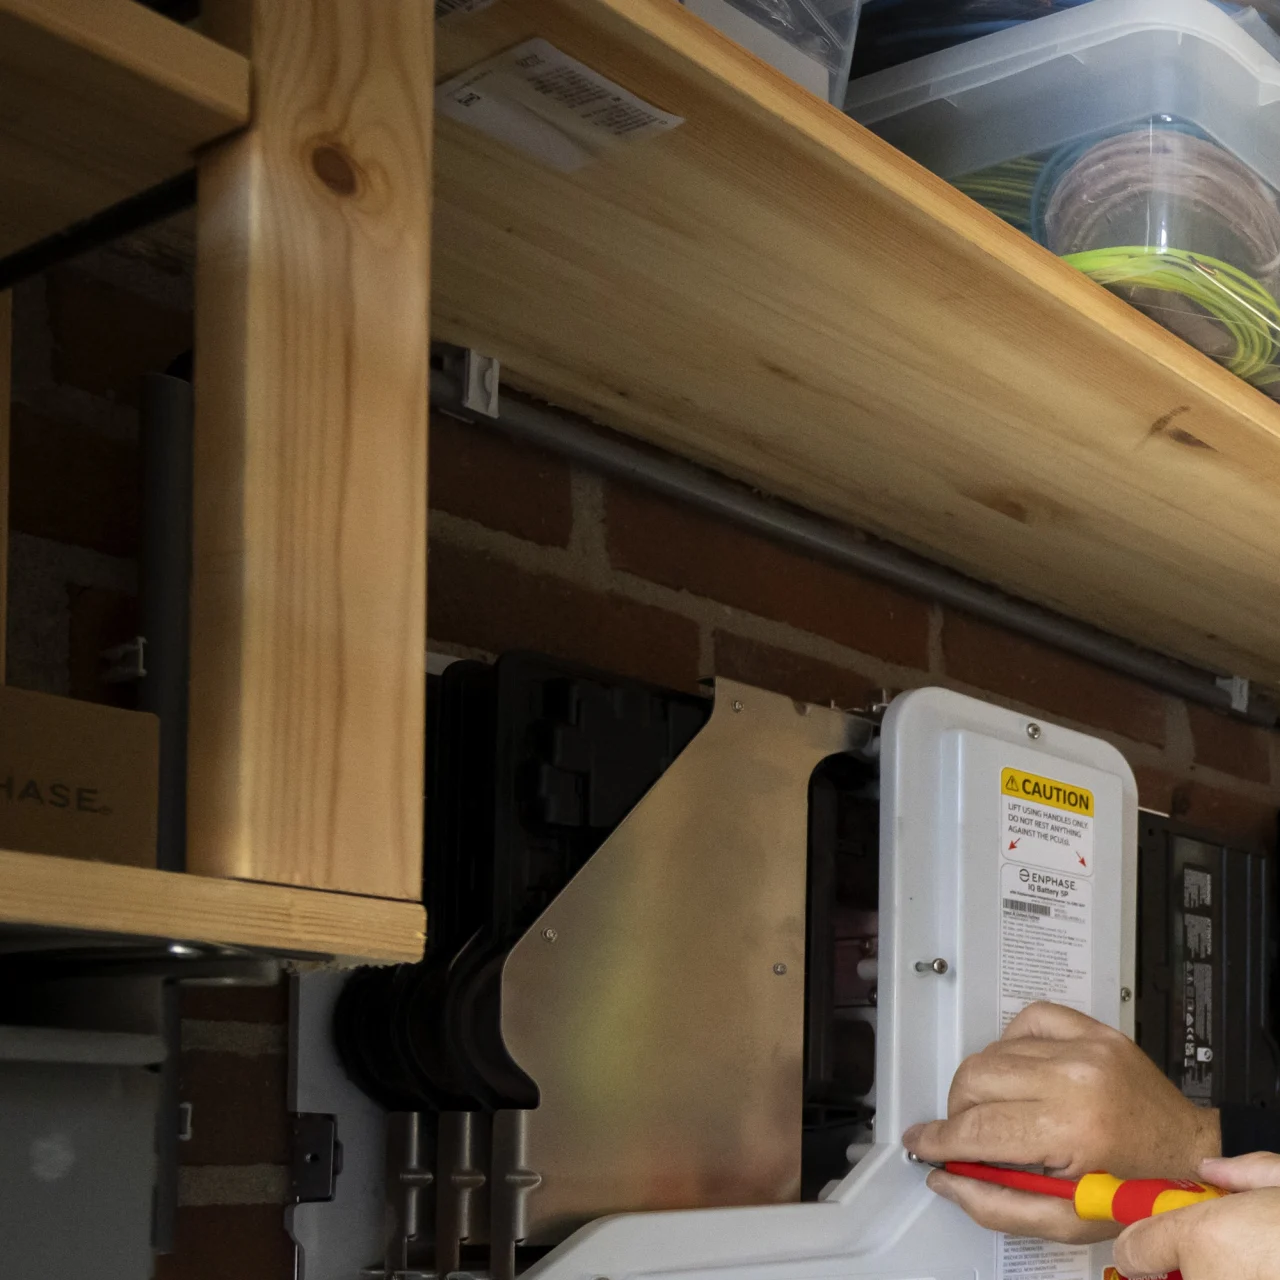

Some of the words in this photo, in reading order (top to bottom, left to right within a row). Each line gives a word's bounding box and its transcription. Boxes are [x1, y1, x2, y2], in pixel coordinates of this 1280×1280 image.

[1022, 779, 1089, 811] CAUTION
[1008, 802, 1021, 811] LIFT
[1022, 806, 1042, 817] USING
[1043, 811, 1072, 825] HANDLES
[1008, 814, 1018, 822] DO
[1020, 817, 1033, 826] NOT
[1035, 820, 1049, 830] REST
[1050, 825, 1082, 838] ANYTHING
[1008, 825, 1036, 837] AGAINST
[1037, 831, 1049, 841] THE
[1028, 884, 1035, 892] IQ
[1037, 885, 1059, 898] Battery
[1032, 873, 1076, 890] ENPHASE
